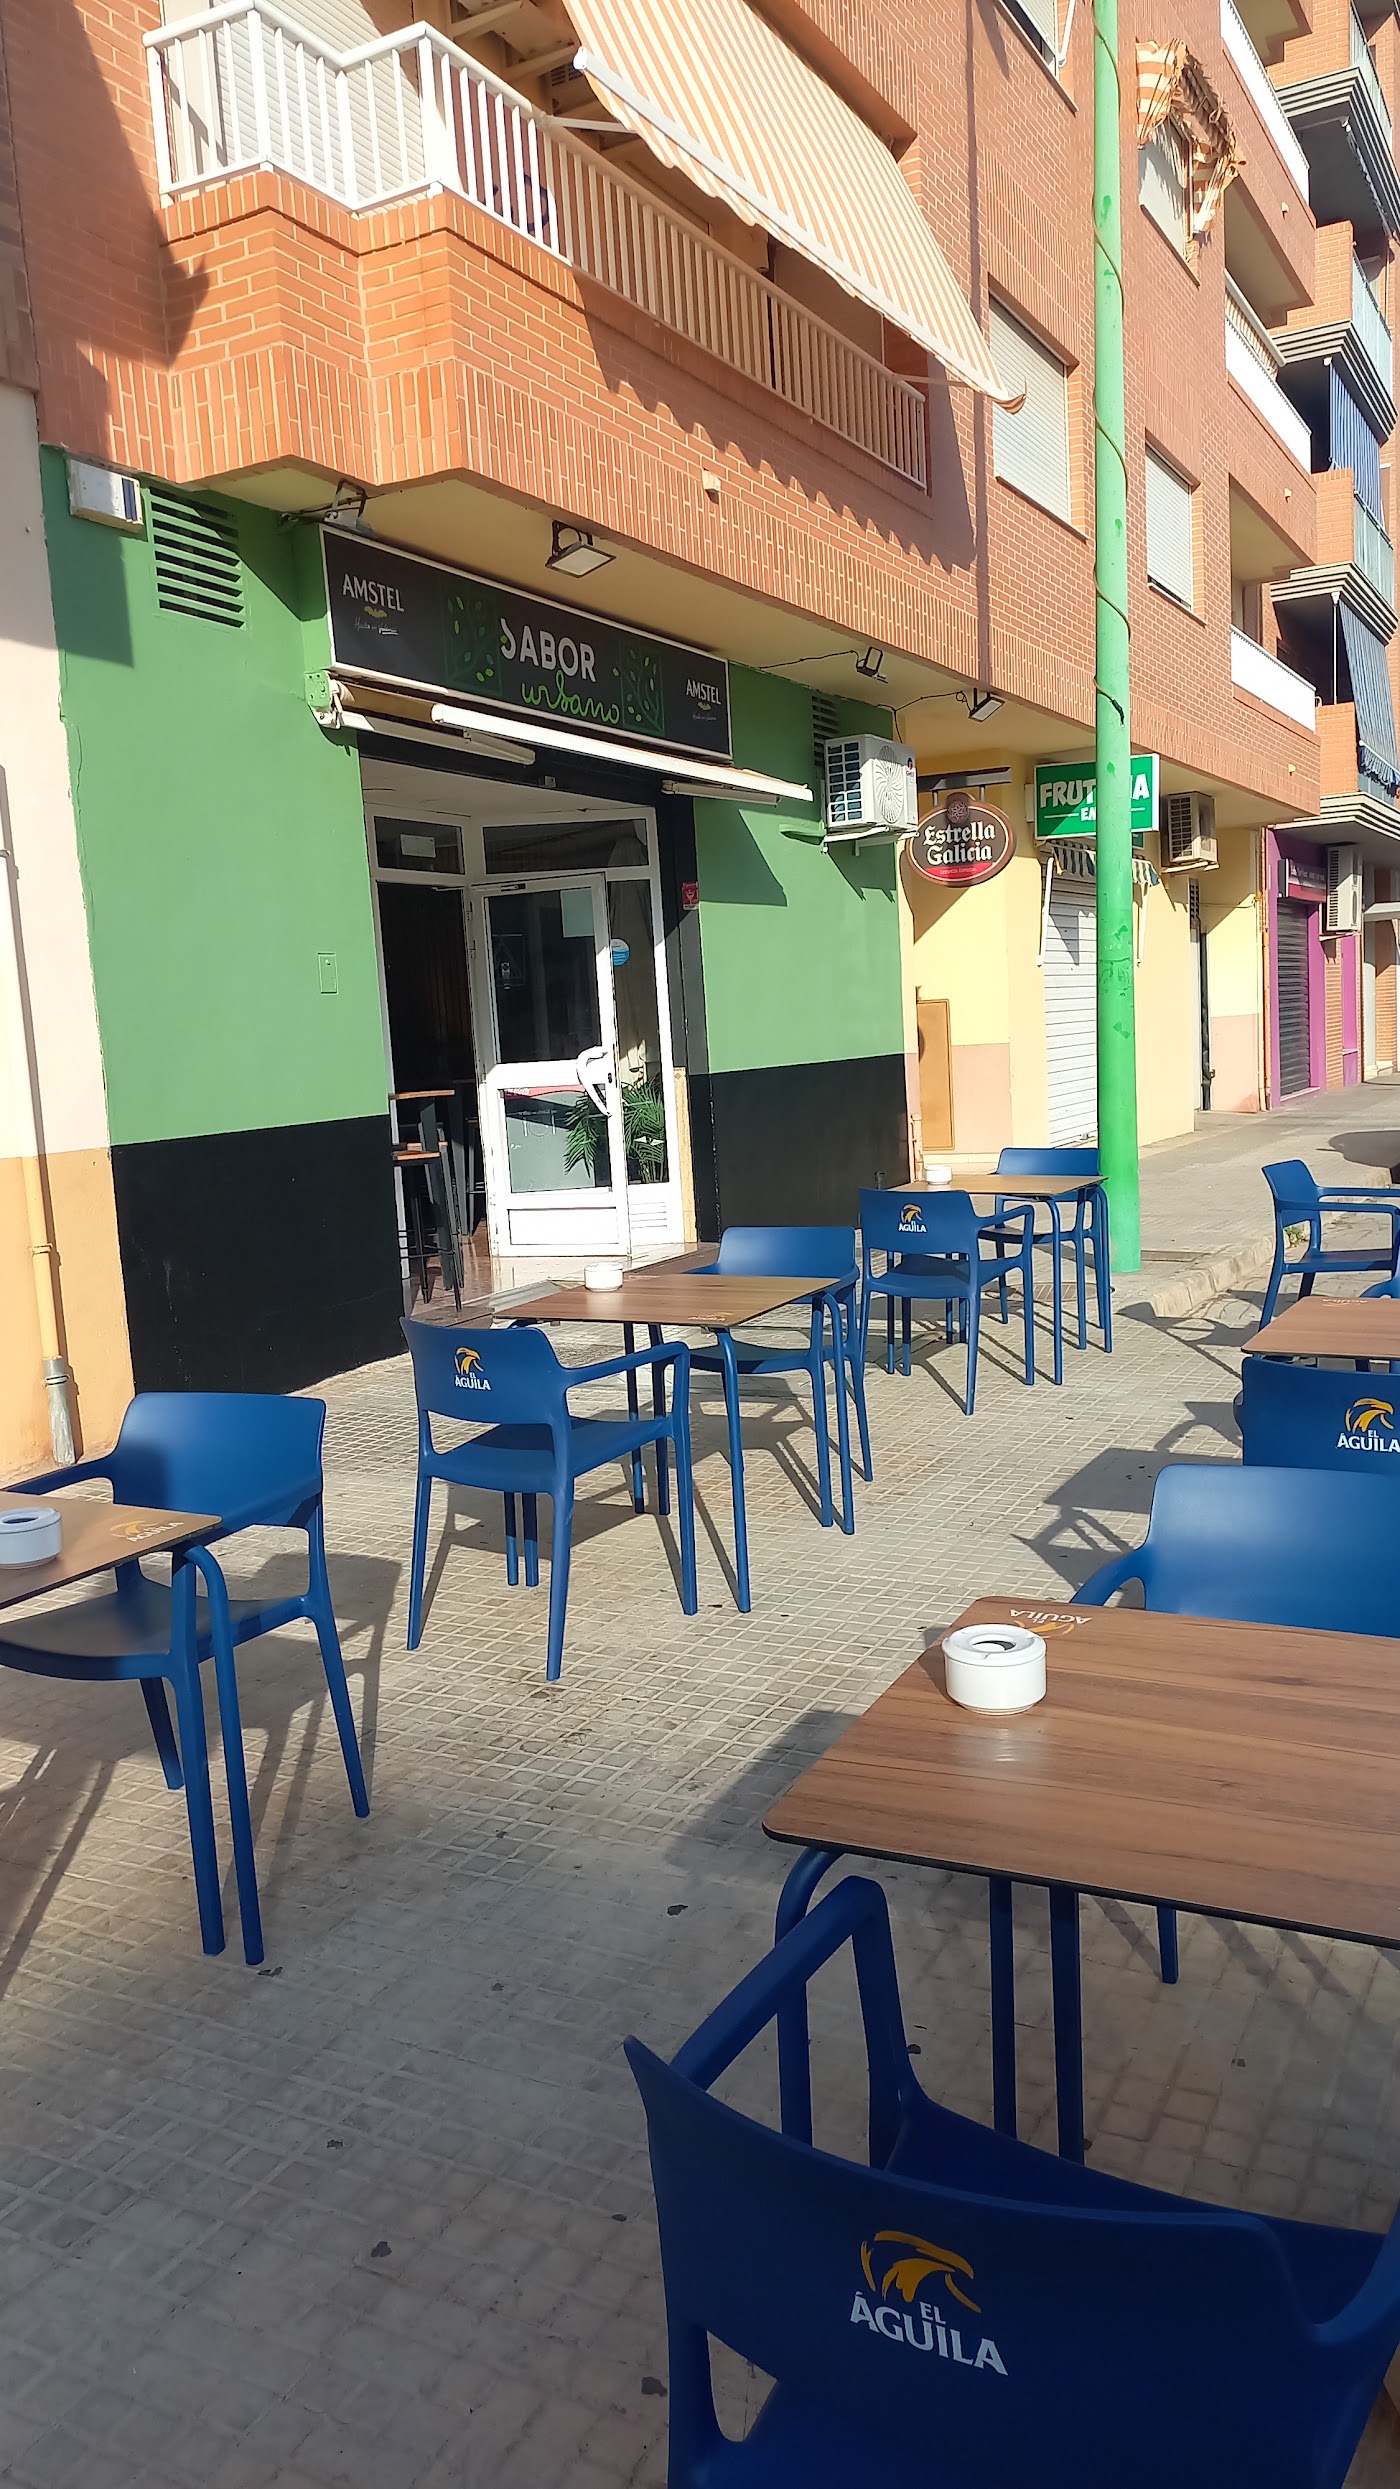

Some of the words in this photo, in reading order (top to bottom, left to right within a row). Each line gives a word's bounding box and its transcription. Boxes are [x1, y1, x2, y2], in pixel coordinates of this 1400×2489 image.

[342, 573, 405, 612] AMSTEL
[500, 617, 597, 683] SABOR
[521, 669, 620, 725] urbano
[686, 679, 722, 705] AMSTEL
[923, 820, 996, 846] Estrella
[926, 841, 993, 866] Galicia
[1367, 1429, 1380, 1438] EL
[919, 2301, 947, 2326] EL
[850, 2290, 1009, 2376] ÁGUILA
